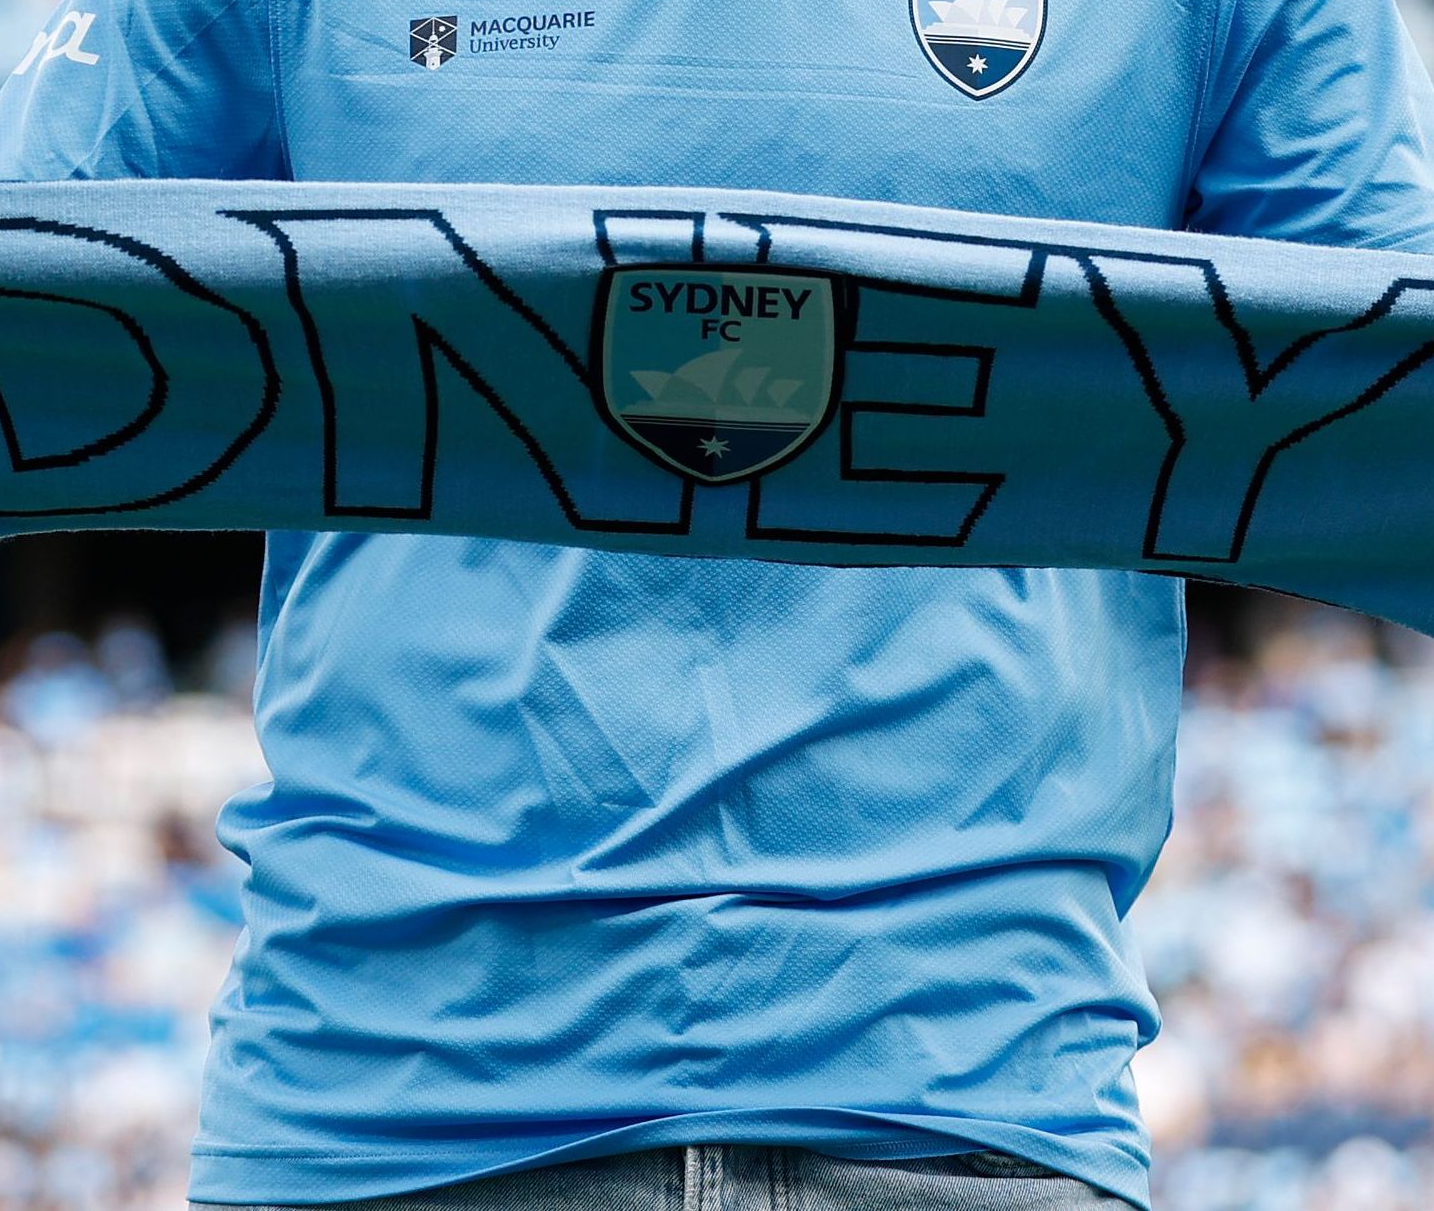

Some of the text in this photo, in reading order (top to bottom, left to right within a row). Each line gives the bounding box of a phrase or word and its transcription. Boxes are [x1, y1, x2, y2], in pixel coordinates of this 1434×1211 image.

[469, 11, 596, 37] MACQUARIE
[469, 33, 560, 54] University
[629, 282, 813, 320] SYDNEY
[701, 319, 742, 342] FC
